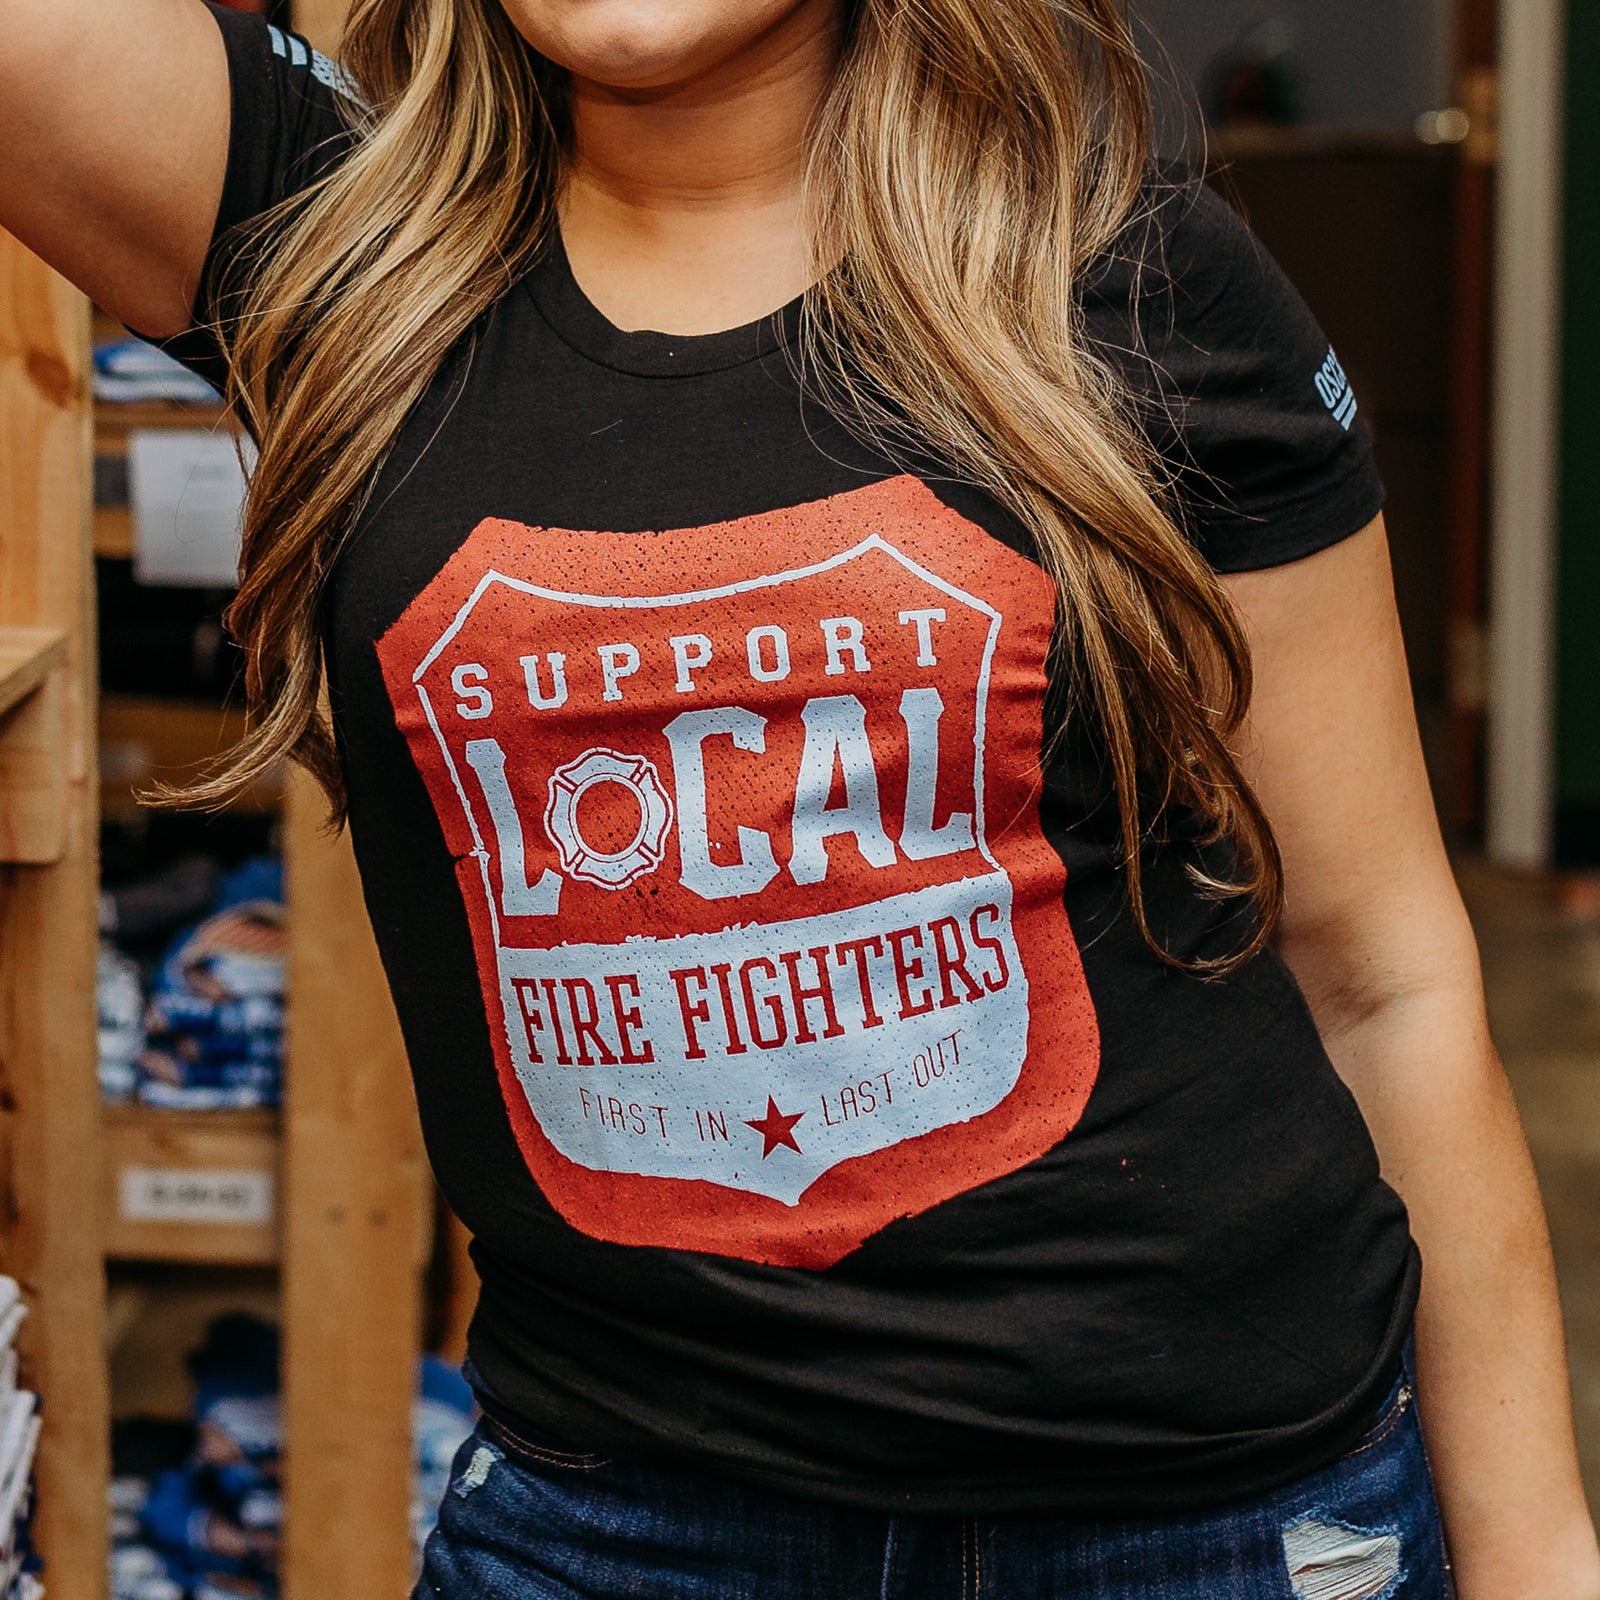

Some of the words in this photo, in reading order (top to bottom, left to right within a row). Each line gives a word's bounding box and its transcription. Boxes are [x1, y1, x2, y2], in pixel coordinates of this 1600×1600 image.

[451, 608, 946, 720] SUPPORT
[466, 687, 974, 916] LOCAL
[511, 974, 655, 1066] FIRE
[669, 903, 1011, 1060] FIGHTERS
[578, 1086, 669, 1139] FIRST
[694, 1110, 730, 1142] IN
[820, 1068, 896, 1127] LAST
[912, 1028, 963, 1089] OUT
